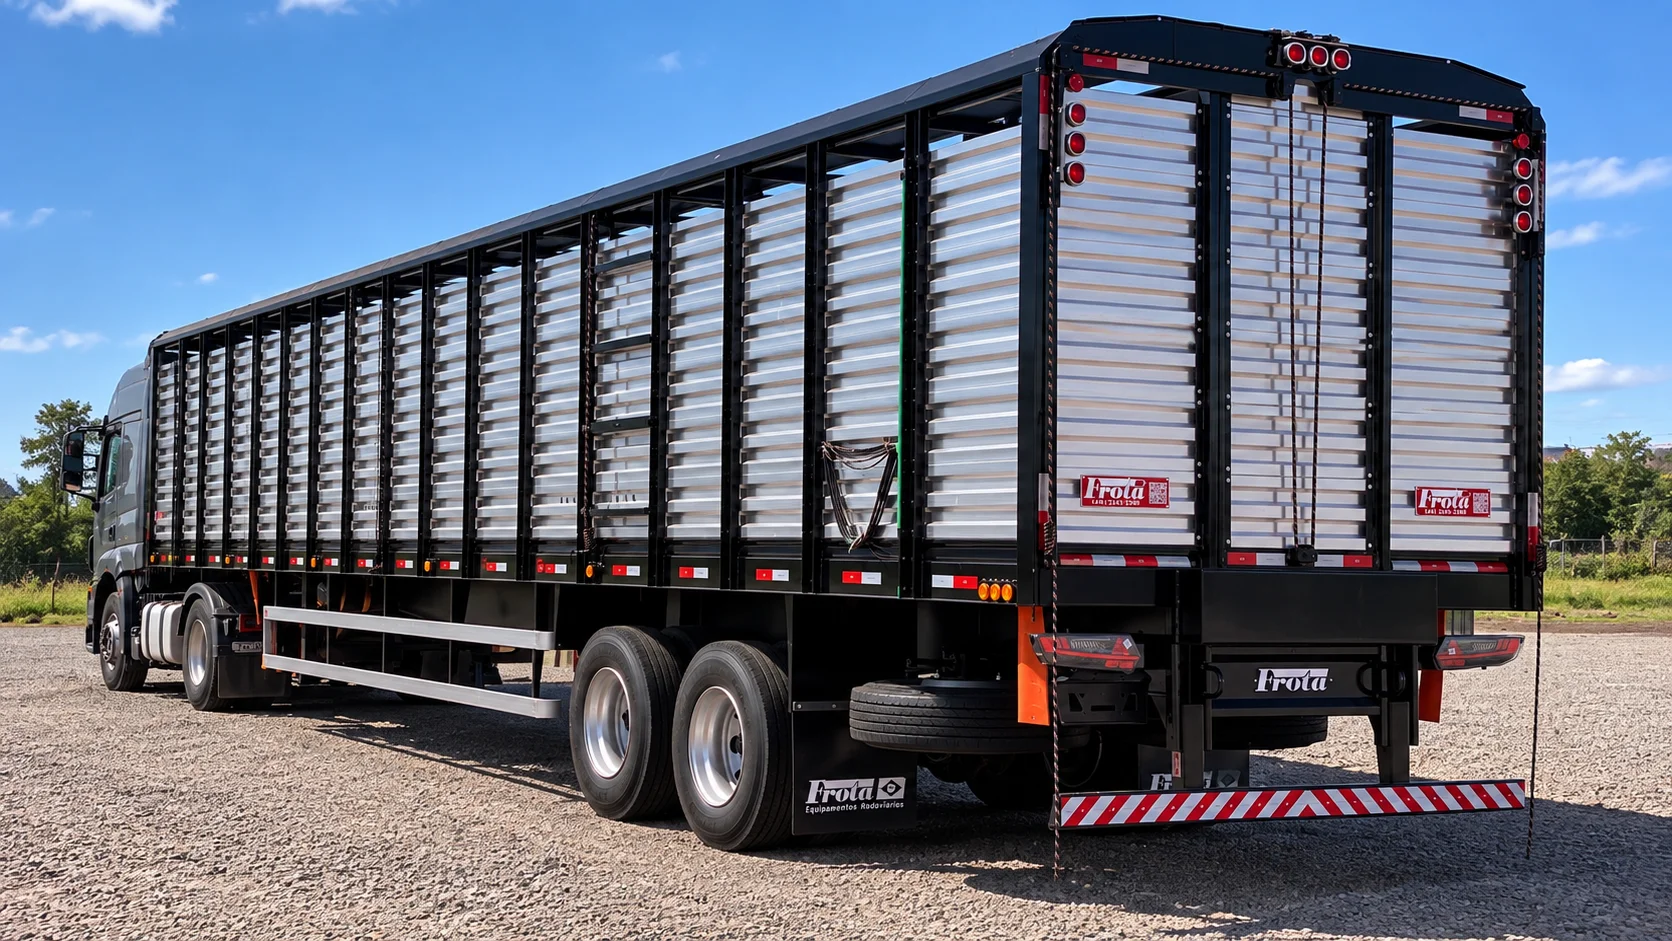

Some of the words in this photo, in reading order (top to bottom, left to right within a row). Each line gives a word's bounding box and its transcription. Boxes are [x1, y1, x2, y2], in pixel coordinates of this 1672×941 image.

[1083, 477, 1147, 500] Frota
[1418, 488, 1471, 509] Frota
[1255, 668, 1329, 692] Frota
[805, 778, 875, 804] Frota
[805, 803, 858, 815] Equipamentos
